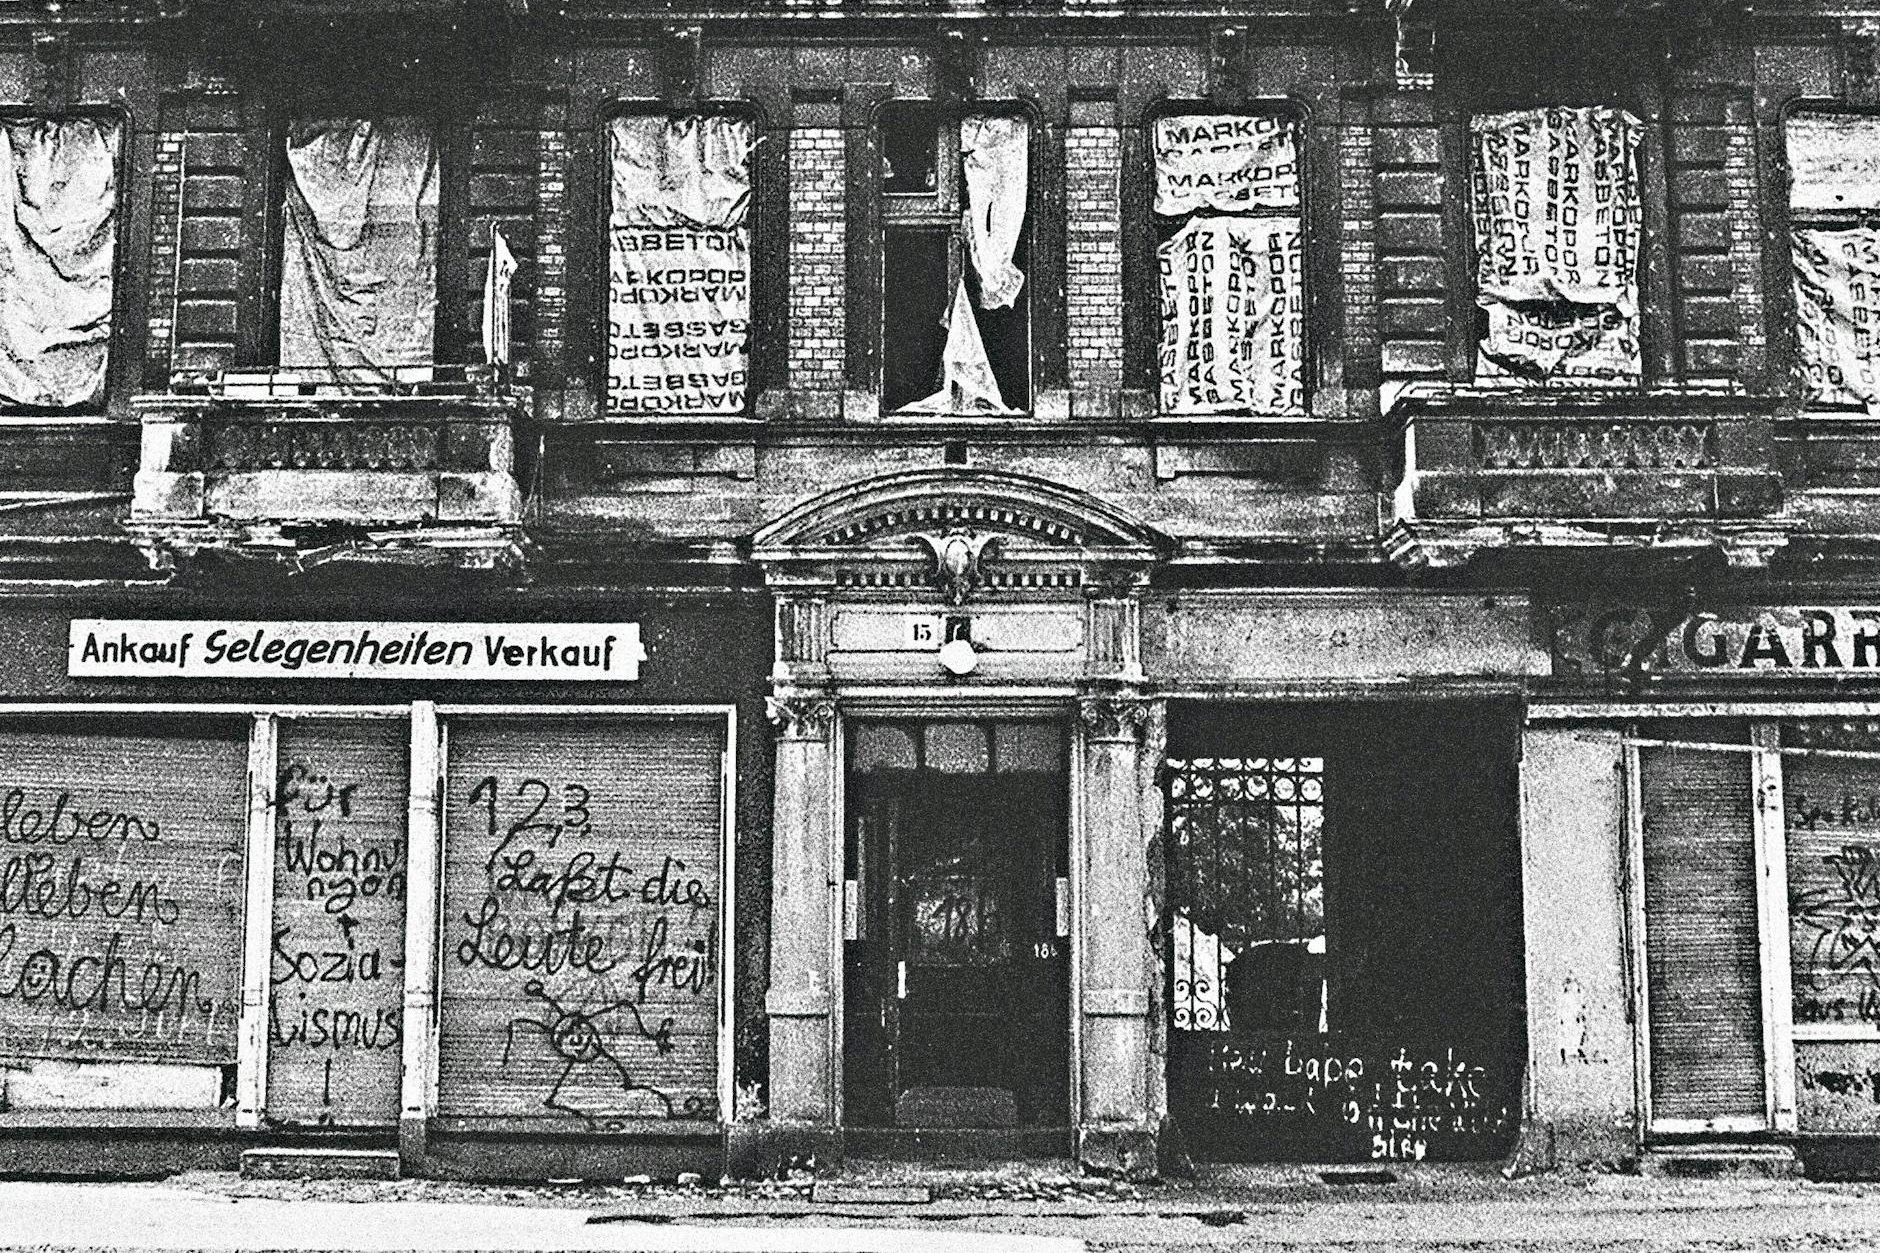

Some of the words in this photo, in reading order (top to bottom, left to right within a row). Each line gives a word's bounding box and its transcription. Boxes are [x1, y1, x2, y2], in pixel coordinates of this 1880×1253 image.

[913, 623, 932, 641] 15
[81, 632, 194, 664] Ankauf
[484, 636, 618, 667] Verkauf
